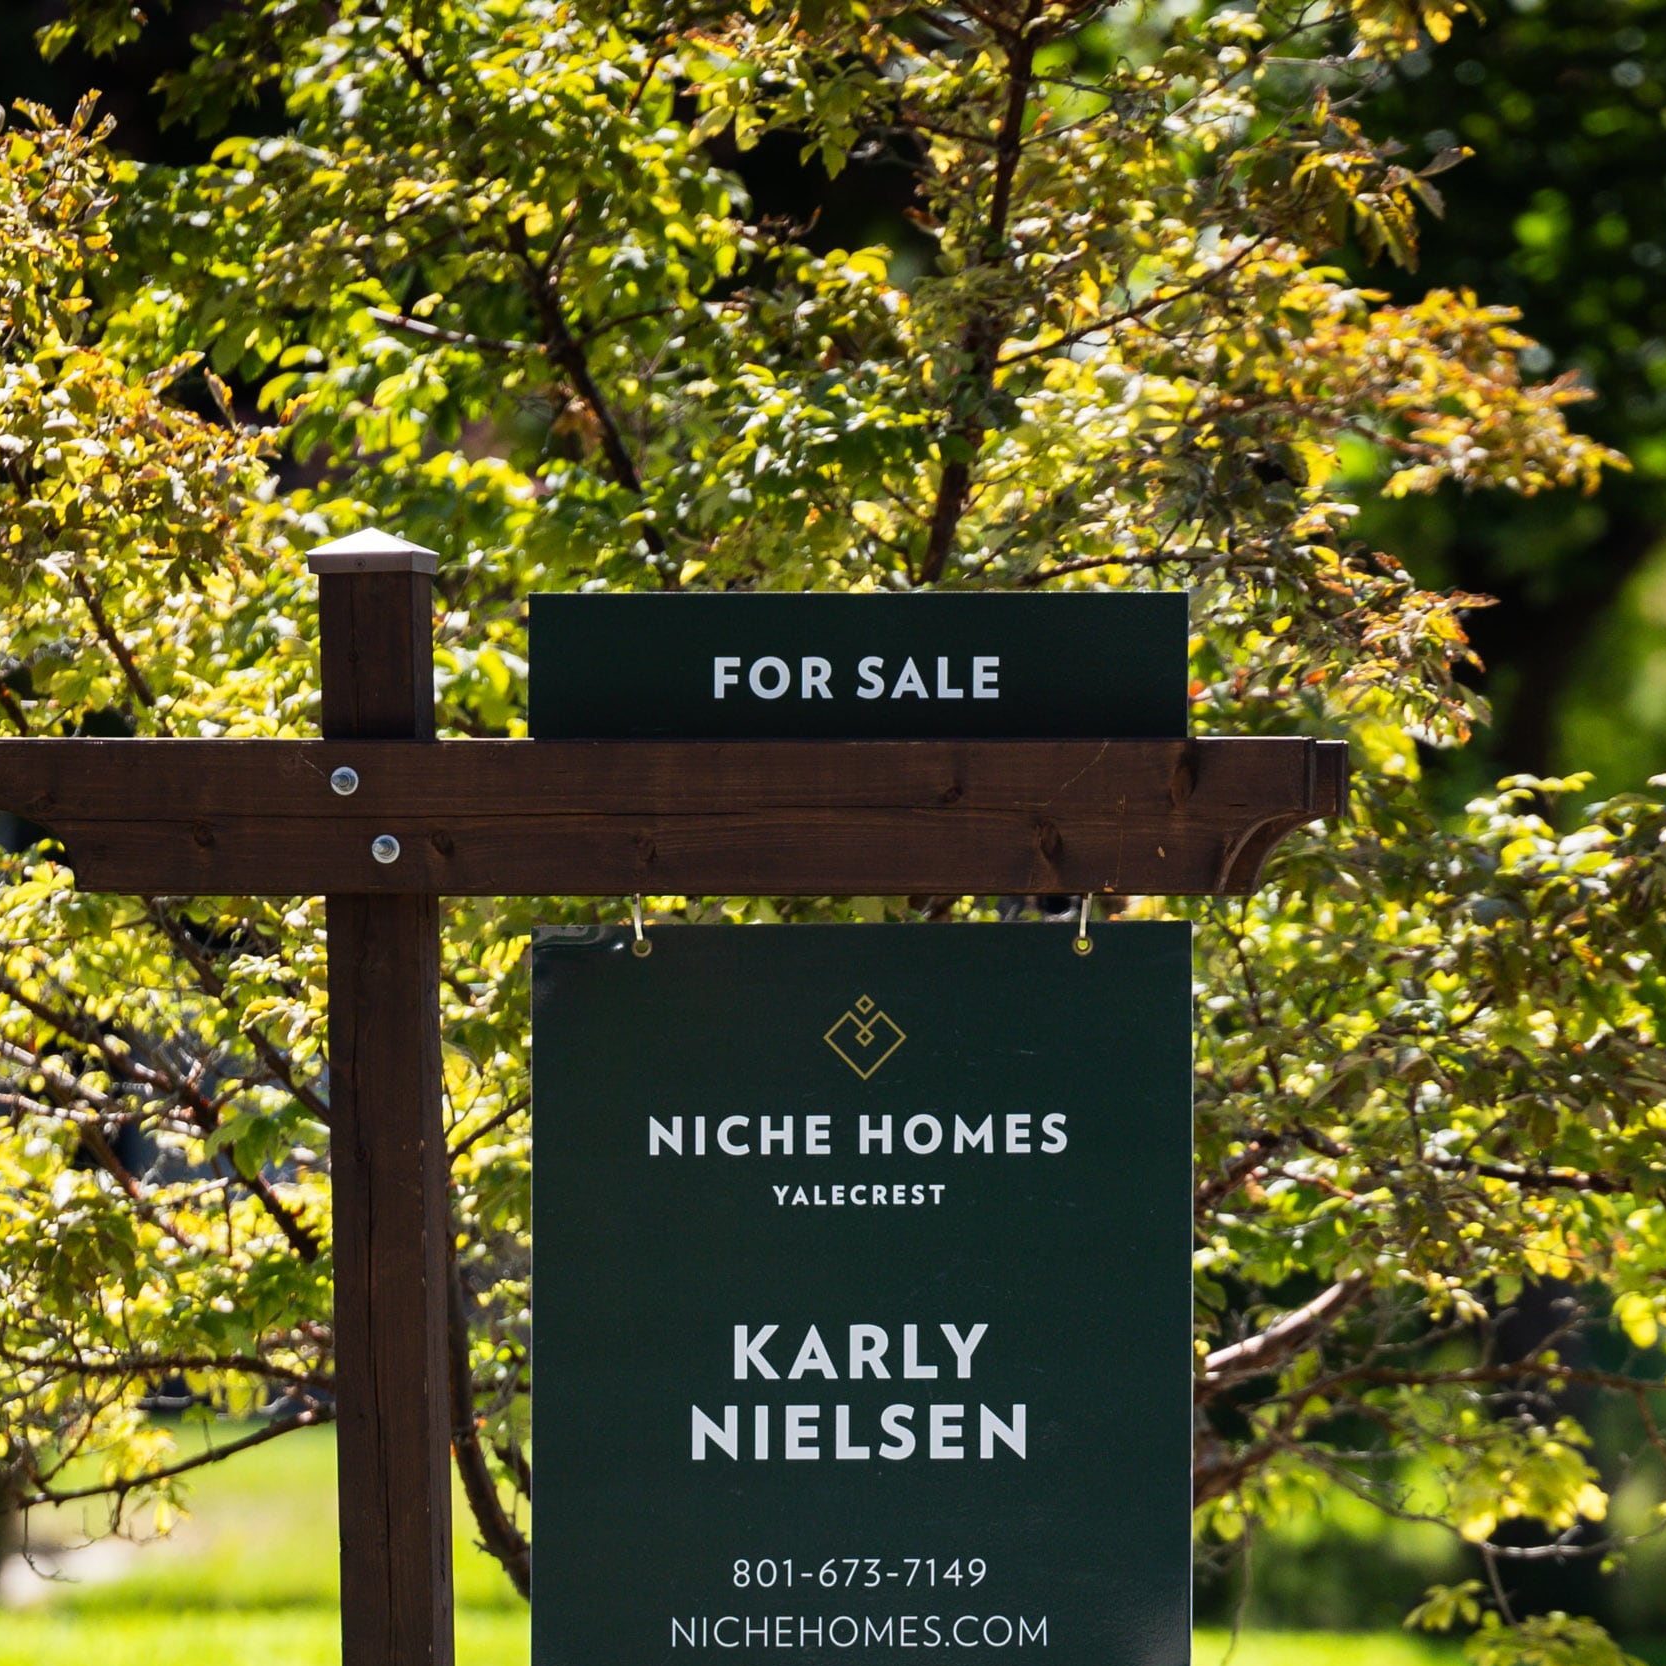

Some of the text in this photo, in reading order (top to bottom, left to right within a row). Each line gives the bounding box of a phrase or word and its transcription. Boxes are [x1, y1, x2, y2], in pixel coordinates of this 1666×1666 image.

[714, 656, 999, 699] FOR SALE
[650, 1113, 1067, 1155] NICHE HOMES
[773, 1185, 945, 1205] YALECREST
[734, 1324, 988, 1379] KARLY
[692, 1403, 1026, 1460] NIELSEN
[734, 1558, 986, 1587] 801-673-7149
[672, 1616, 1047, 1647] NICHEHOMES.COM
